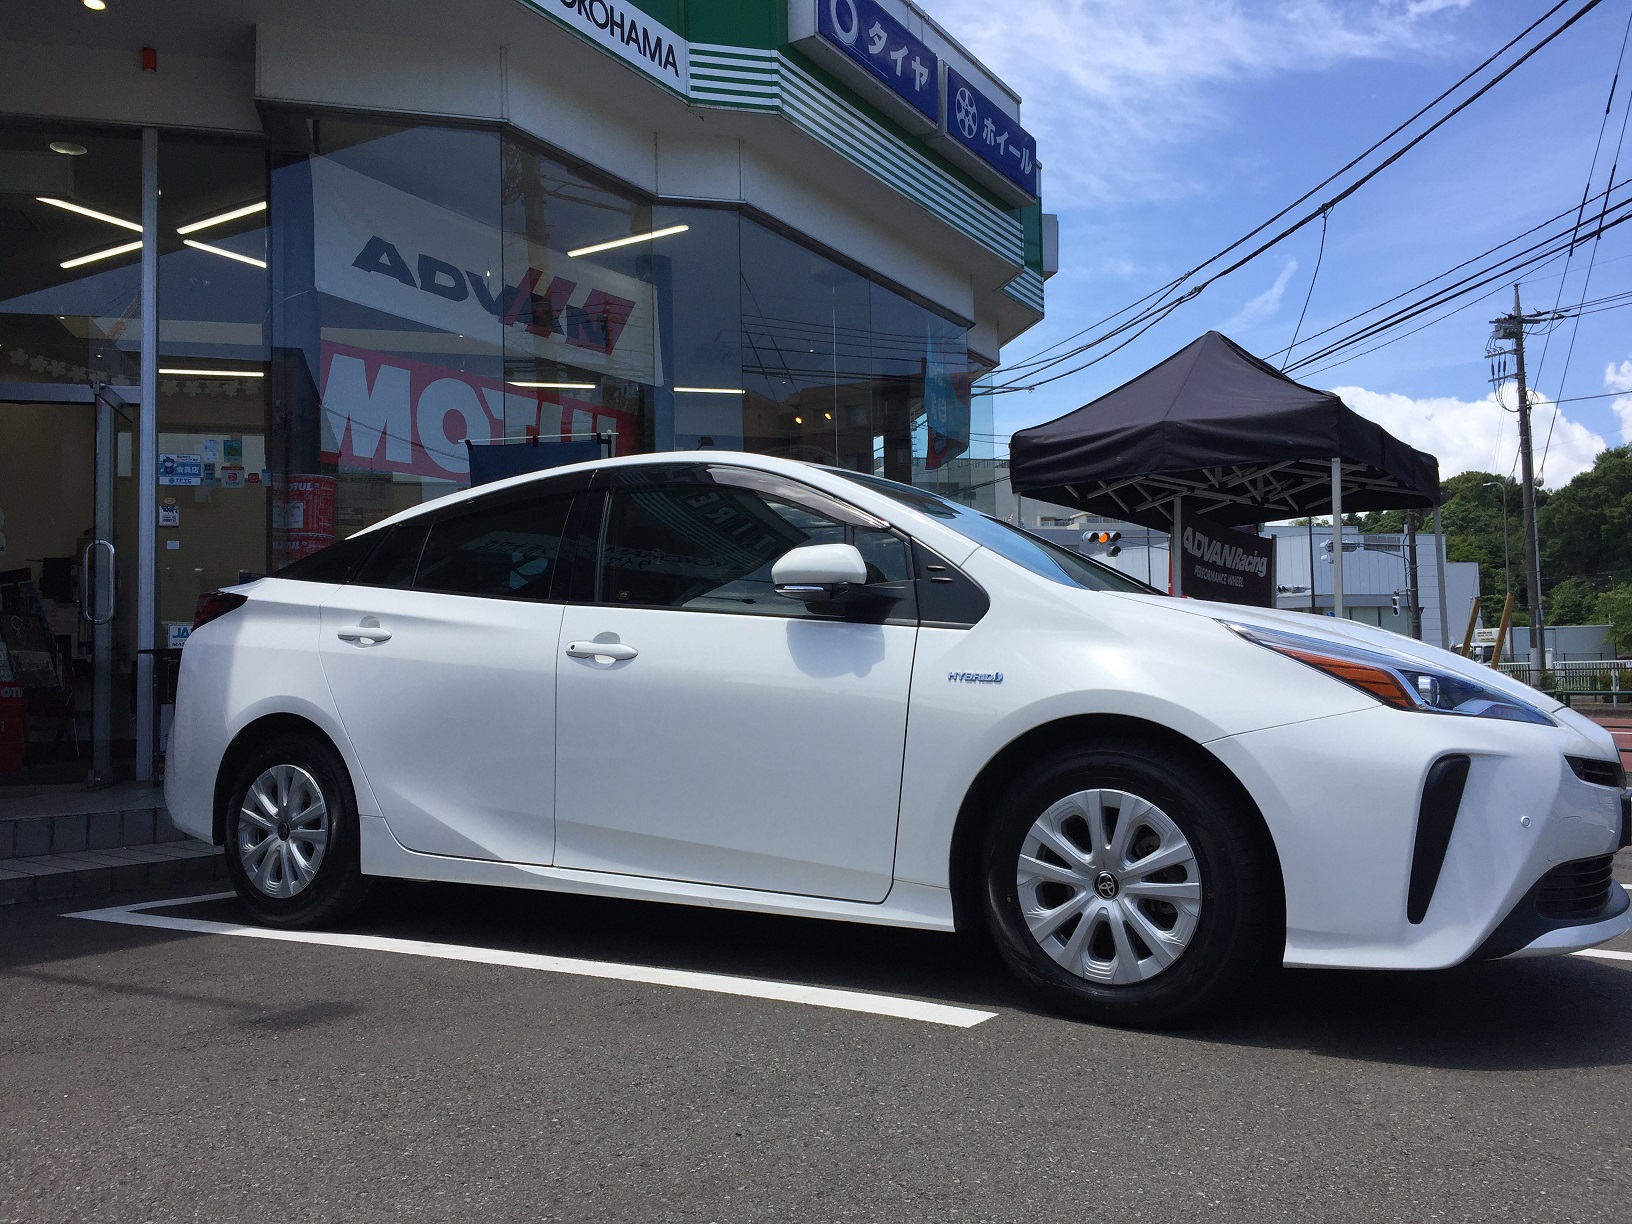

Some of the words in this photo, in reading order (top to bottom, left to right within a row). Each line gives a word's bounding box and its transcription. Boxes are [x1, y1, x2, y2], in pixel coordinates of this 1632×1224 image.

[559, 0, 680, 79] KOHAMA
[868, 21, 929, 92] タイヤ
[982, 117, 1033, 175] ホイール
[1193, 564, 1227, 585] PERFORMANCE
[1227, 573, 1244, 588] WHEEL
[947, 671, 994, 683] HYBRID
